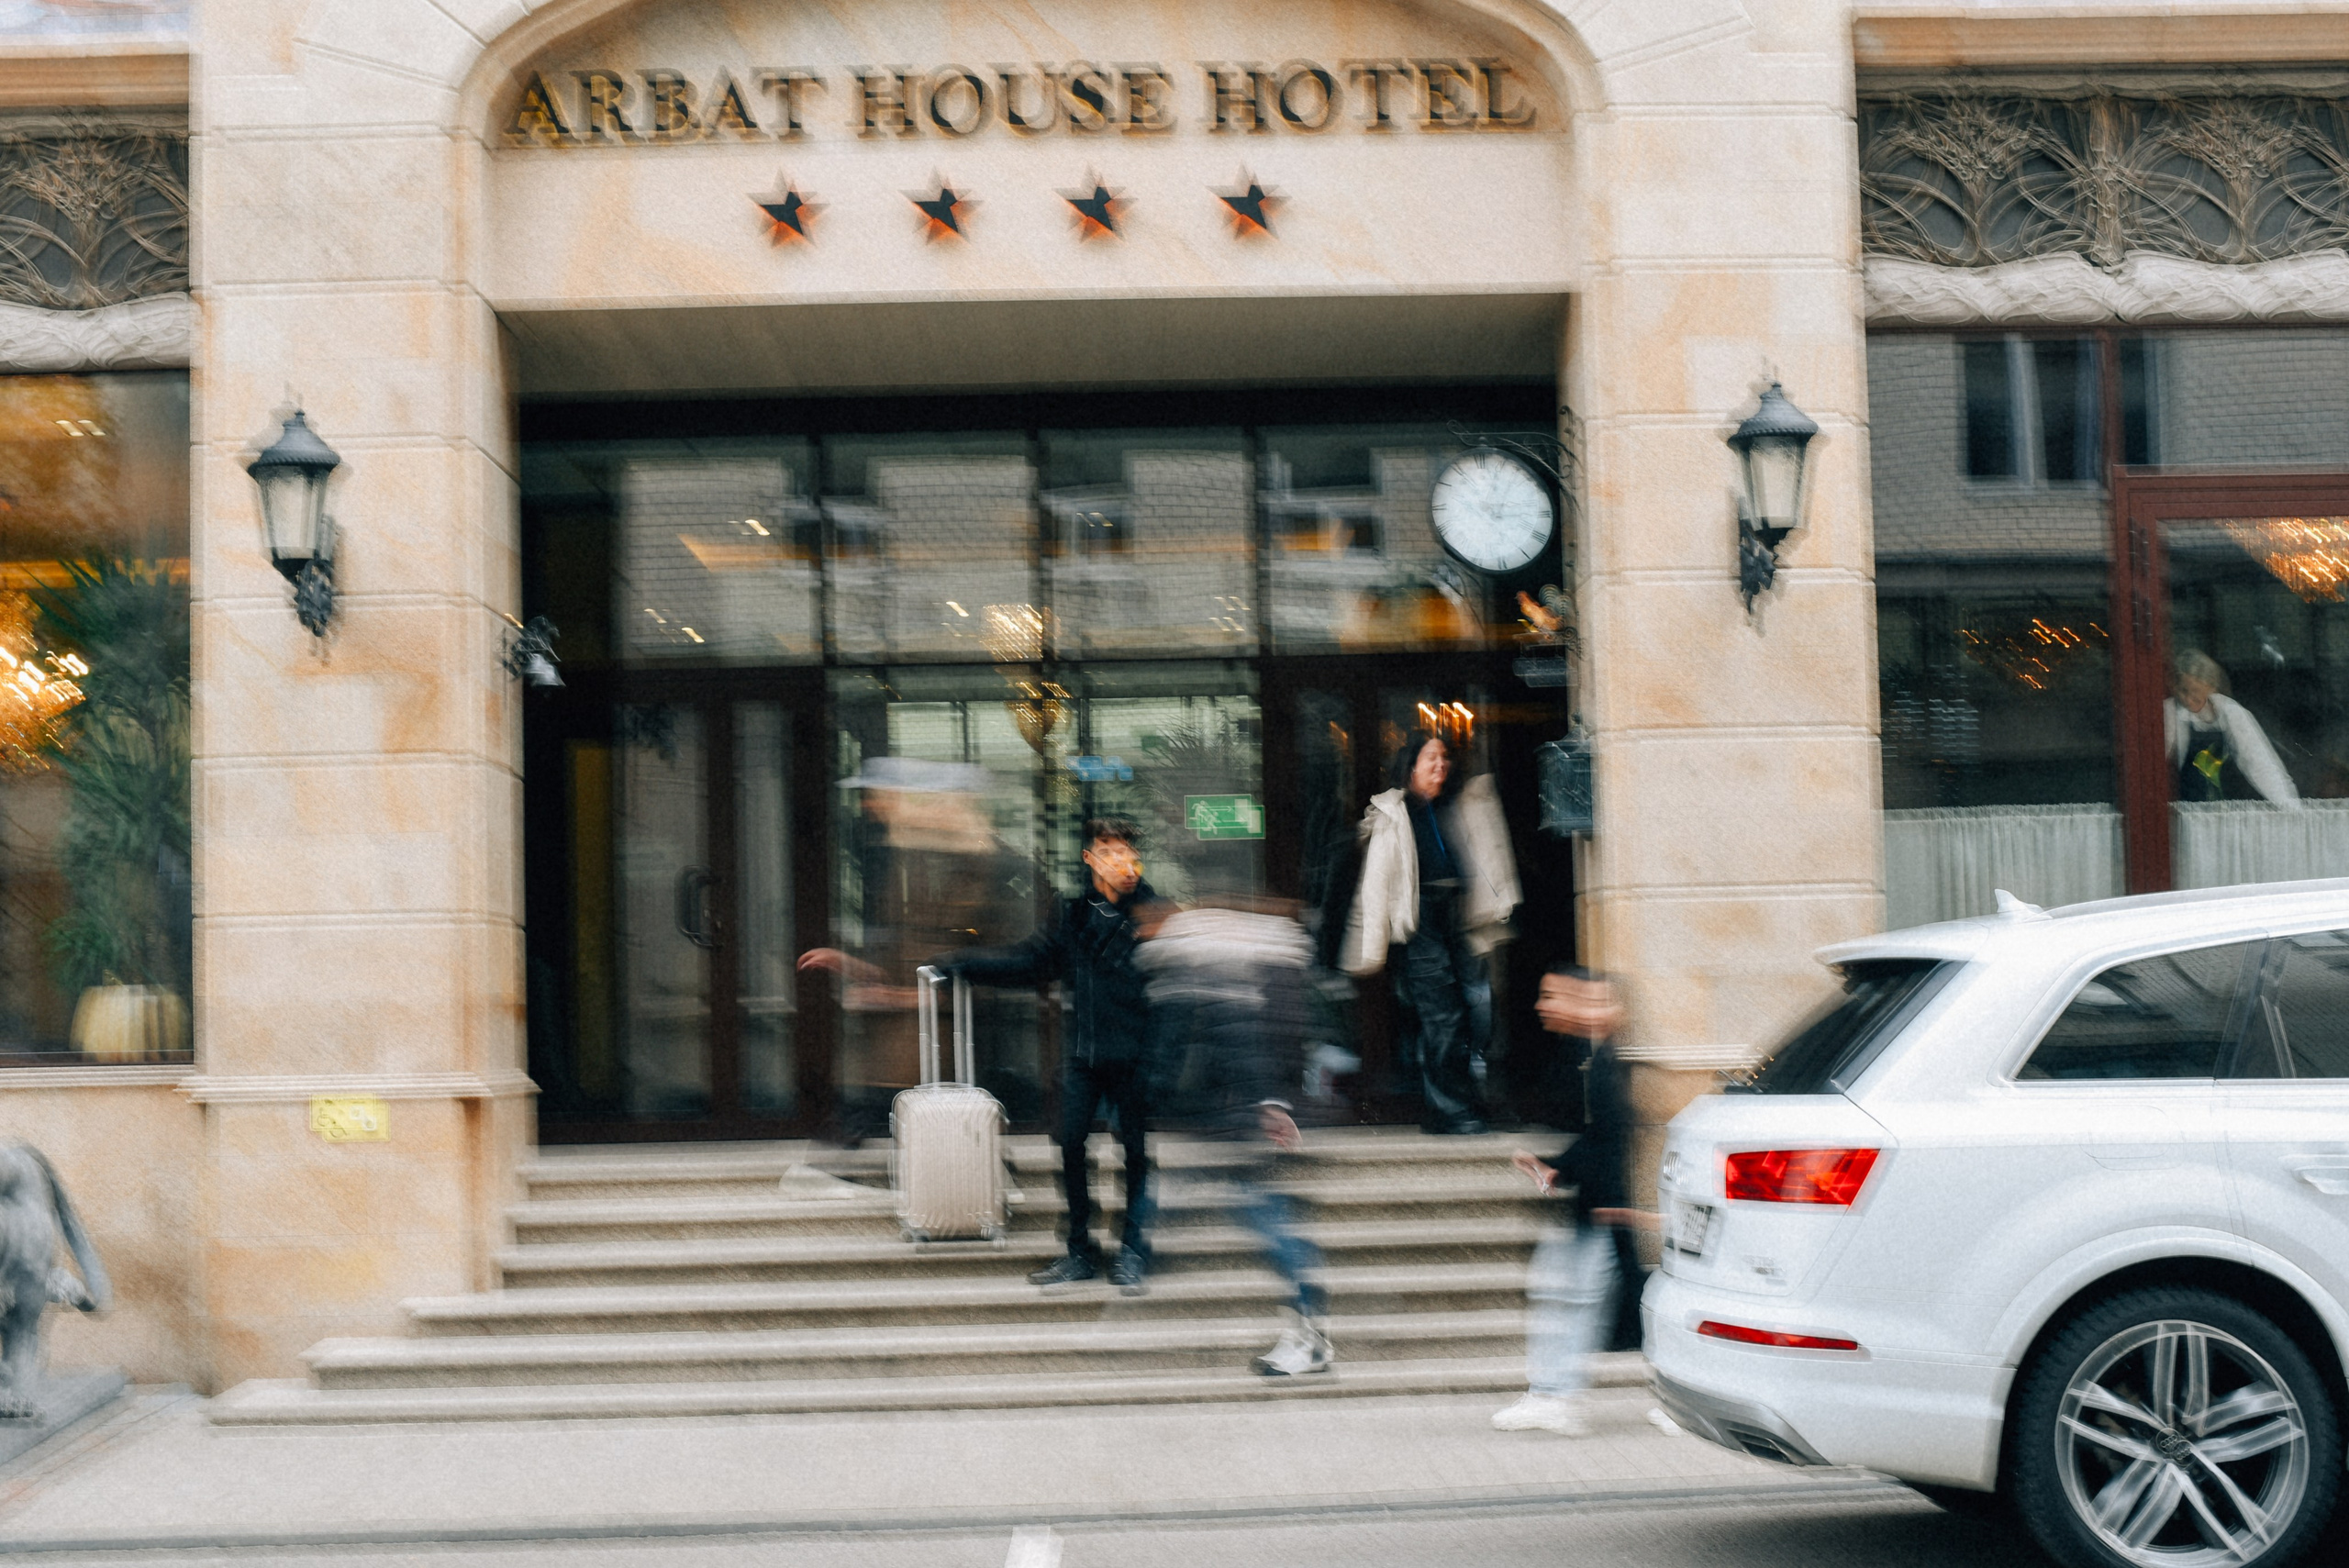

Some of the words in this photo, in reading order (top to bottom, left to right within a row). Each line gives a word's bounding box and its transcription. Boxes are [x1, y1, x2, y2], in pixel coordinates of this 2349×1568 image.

[502, 64, 829, 148] ARBAT
[842, 59, 1178, 139] HOUSE
[1195, 56, 1538, 135] HOTEL
